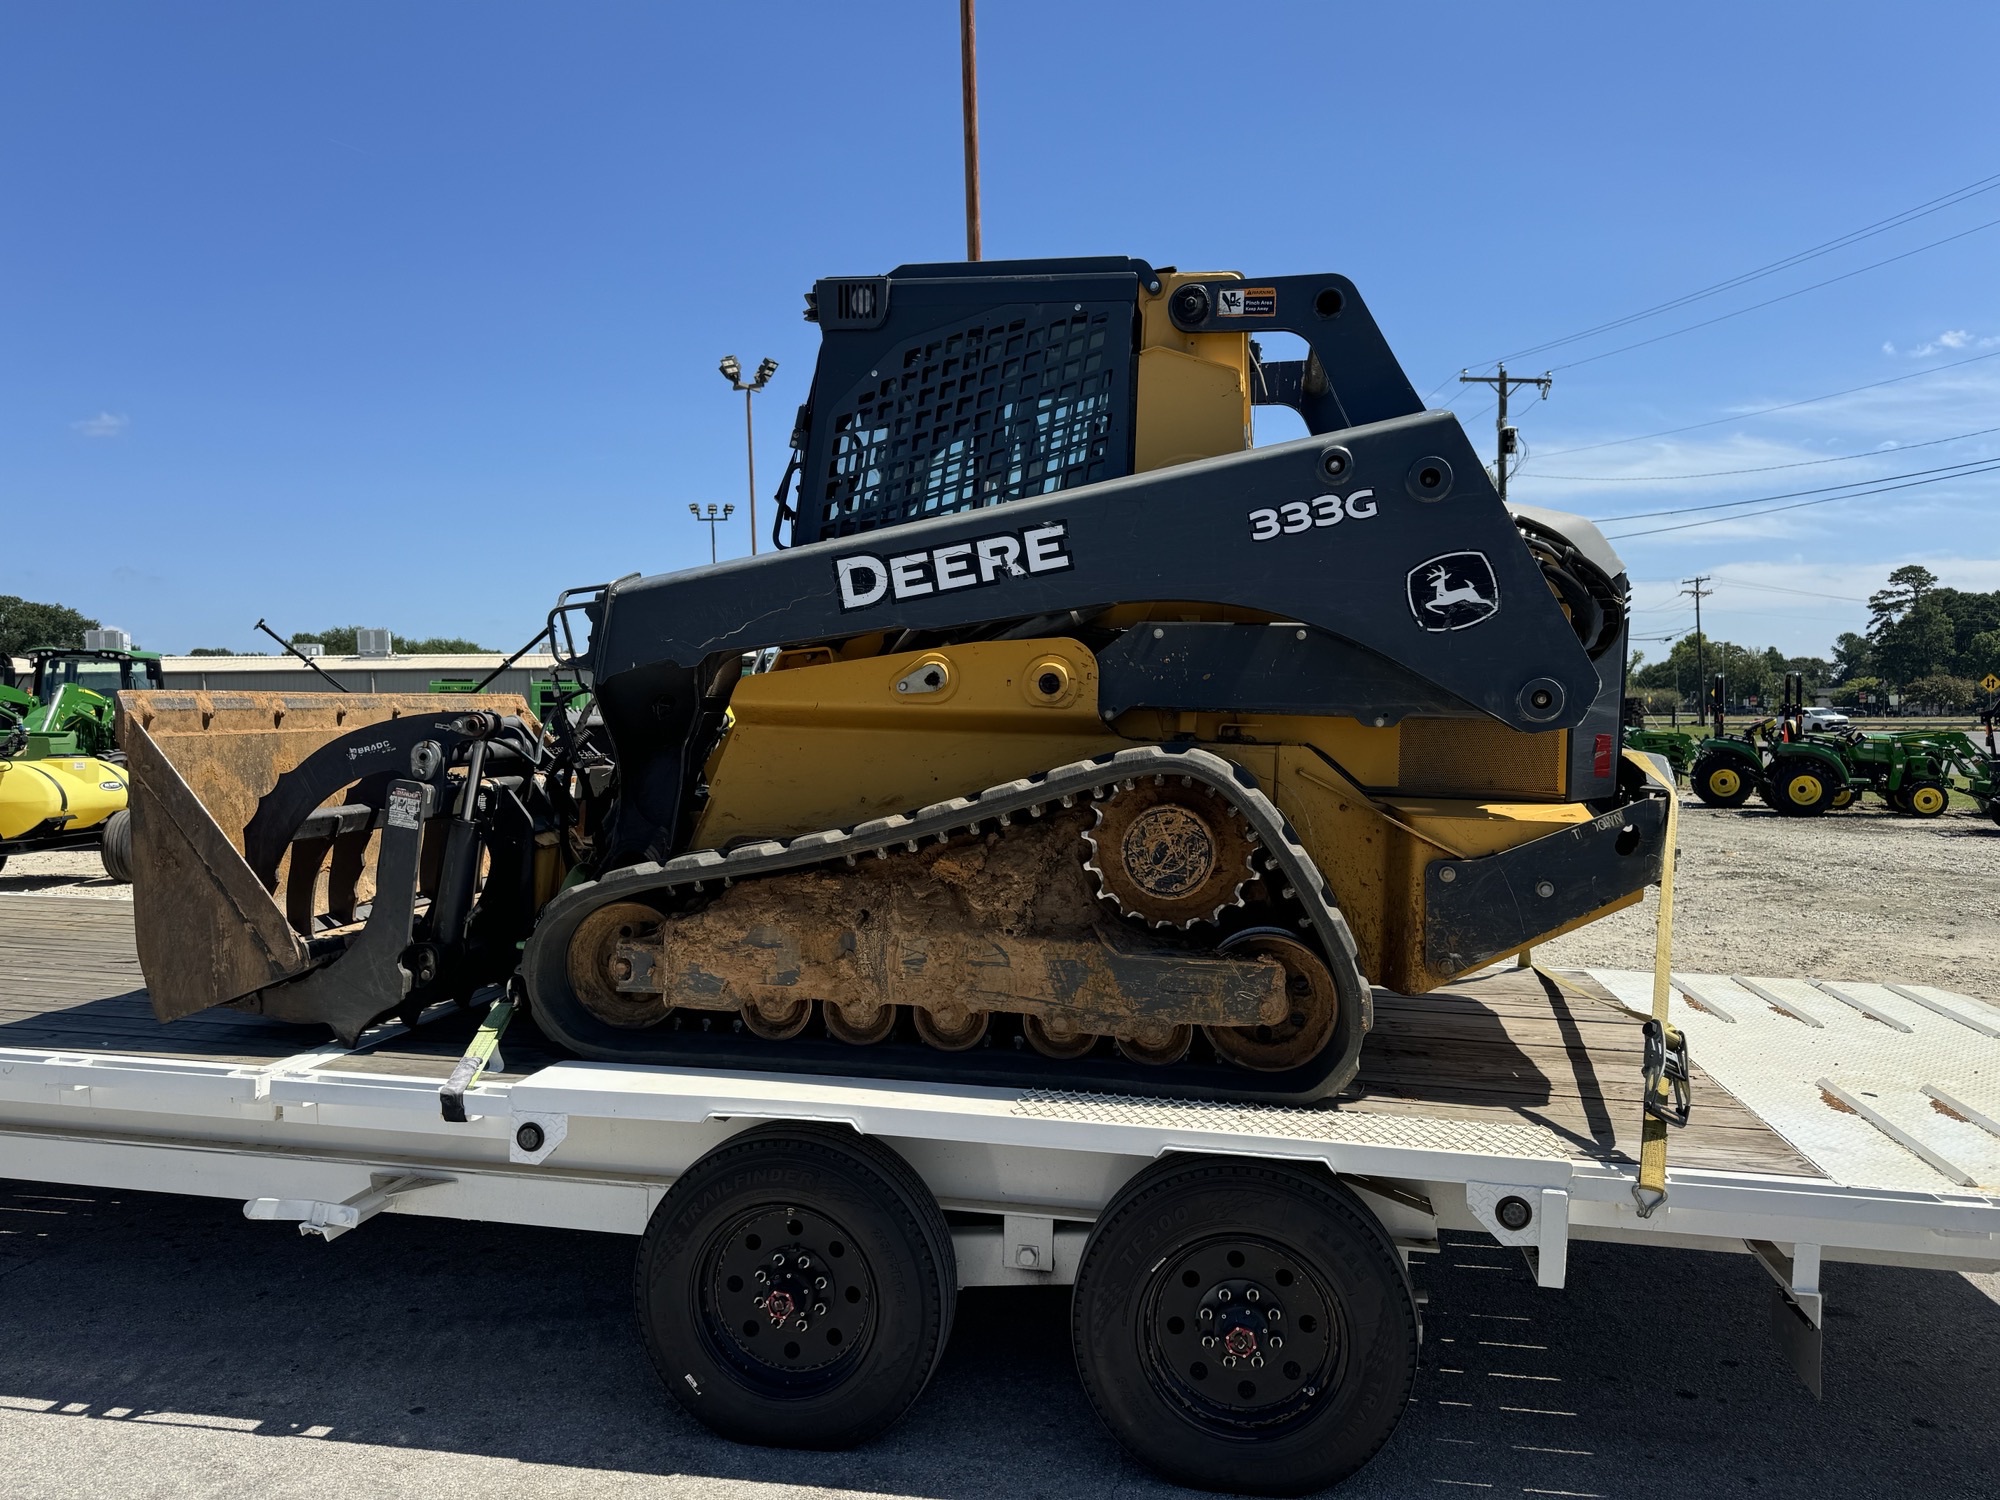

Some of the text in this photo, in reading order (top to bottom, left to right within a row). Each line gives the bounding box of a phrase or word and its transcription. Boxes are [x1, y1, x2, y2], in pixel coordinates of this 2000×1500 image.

[1249, 489, 1378, 541] 333G
[836, 524, 1070, 609] DEERE
[680, 1168, 814, 1227] TRAILFINDER
[1118, 1204, 1190, 1267] TF300
